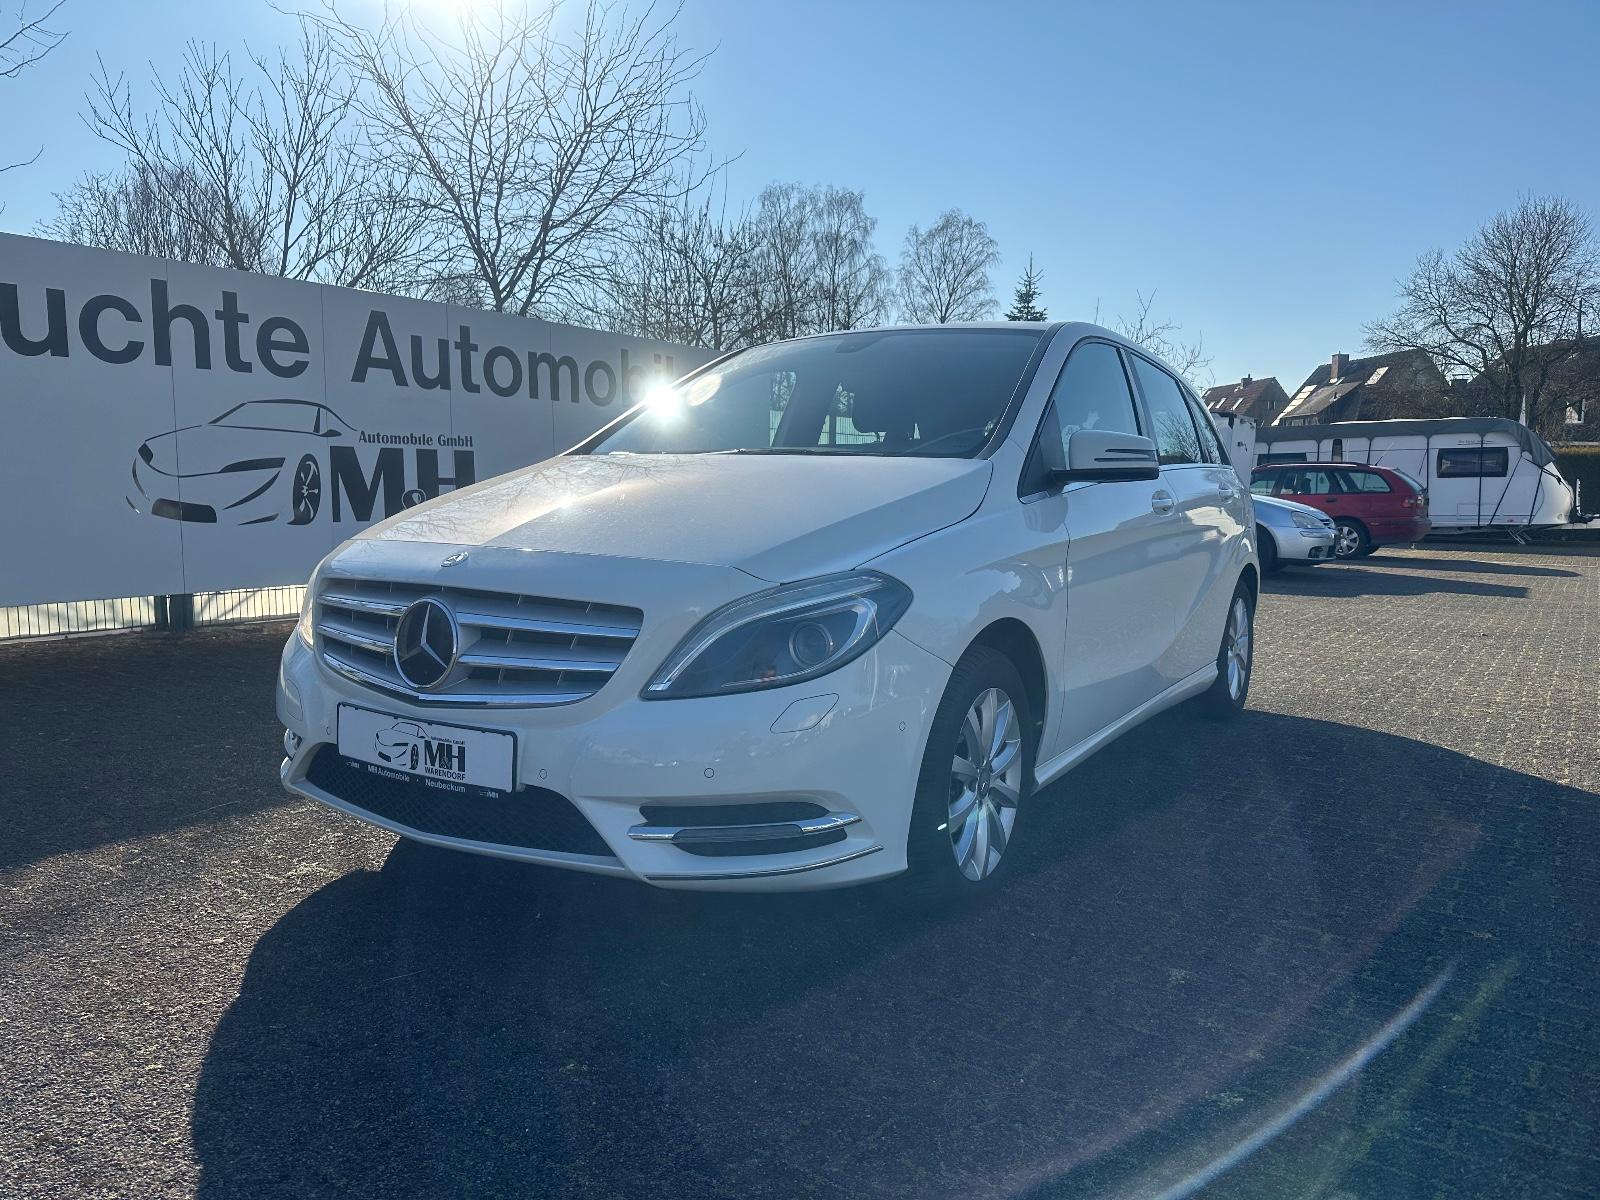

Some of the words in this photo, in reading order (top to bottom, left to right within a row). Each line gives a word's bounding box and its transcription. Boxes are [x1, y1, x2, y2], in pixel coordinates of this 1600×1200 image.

[358, 430, 433, 446] Automobile
[437, 434, 473, 447] GmbH
[424, 766, 466, 781] WARENDORF
[425, 777, 466, 793] Neubeckum
